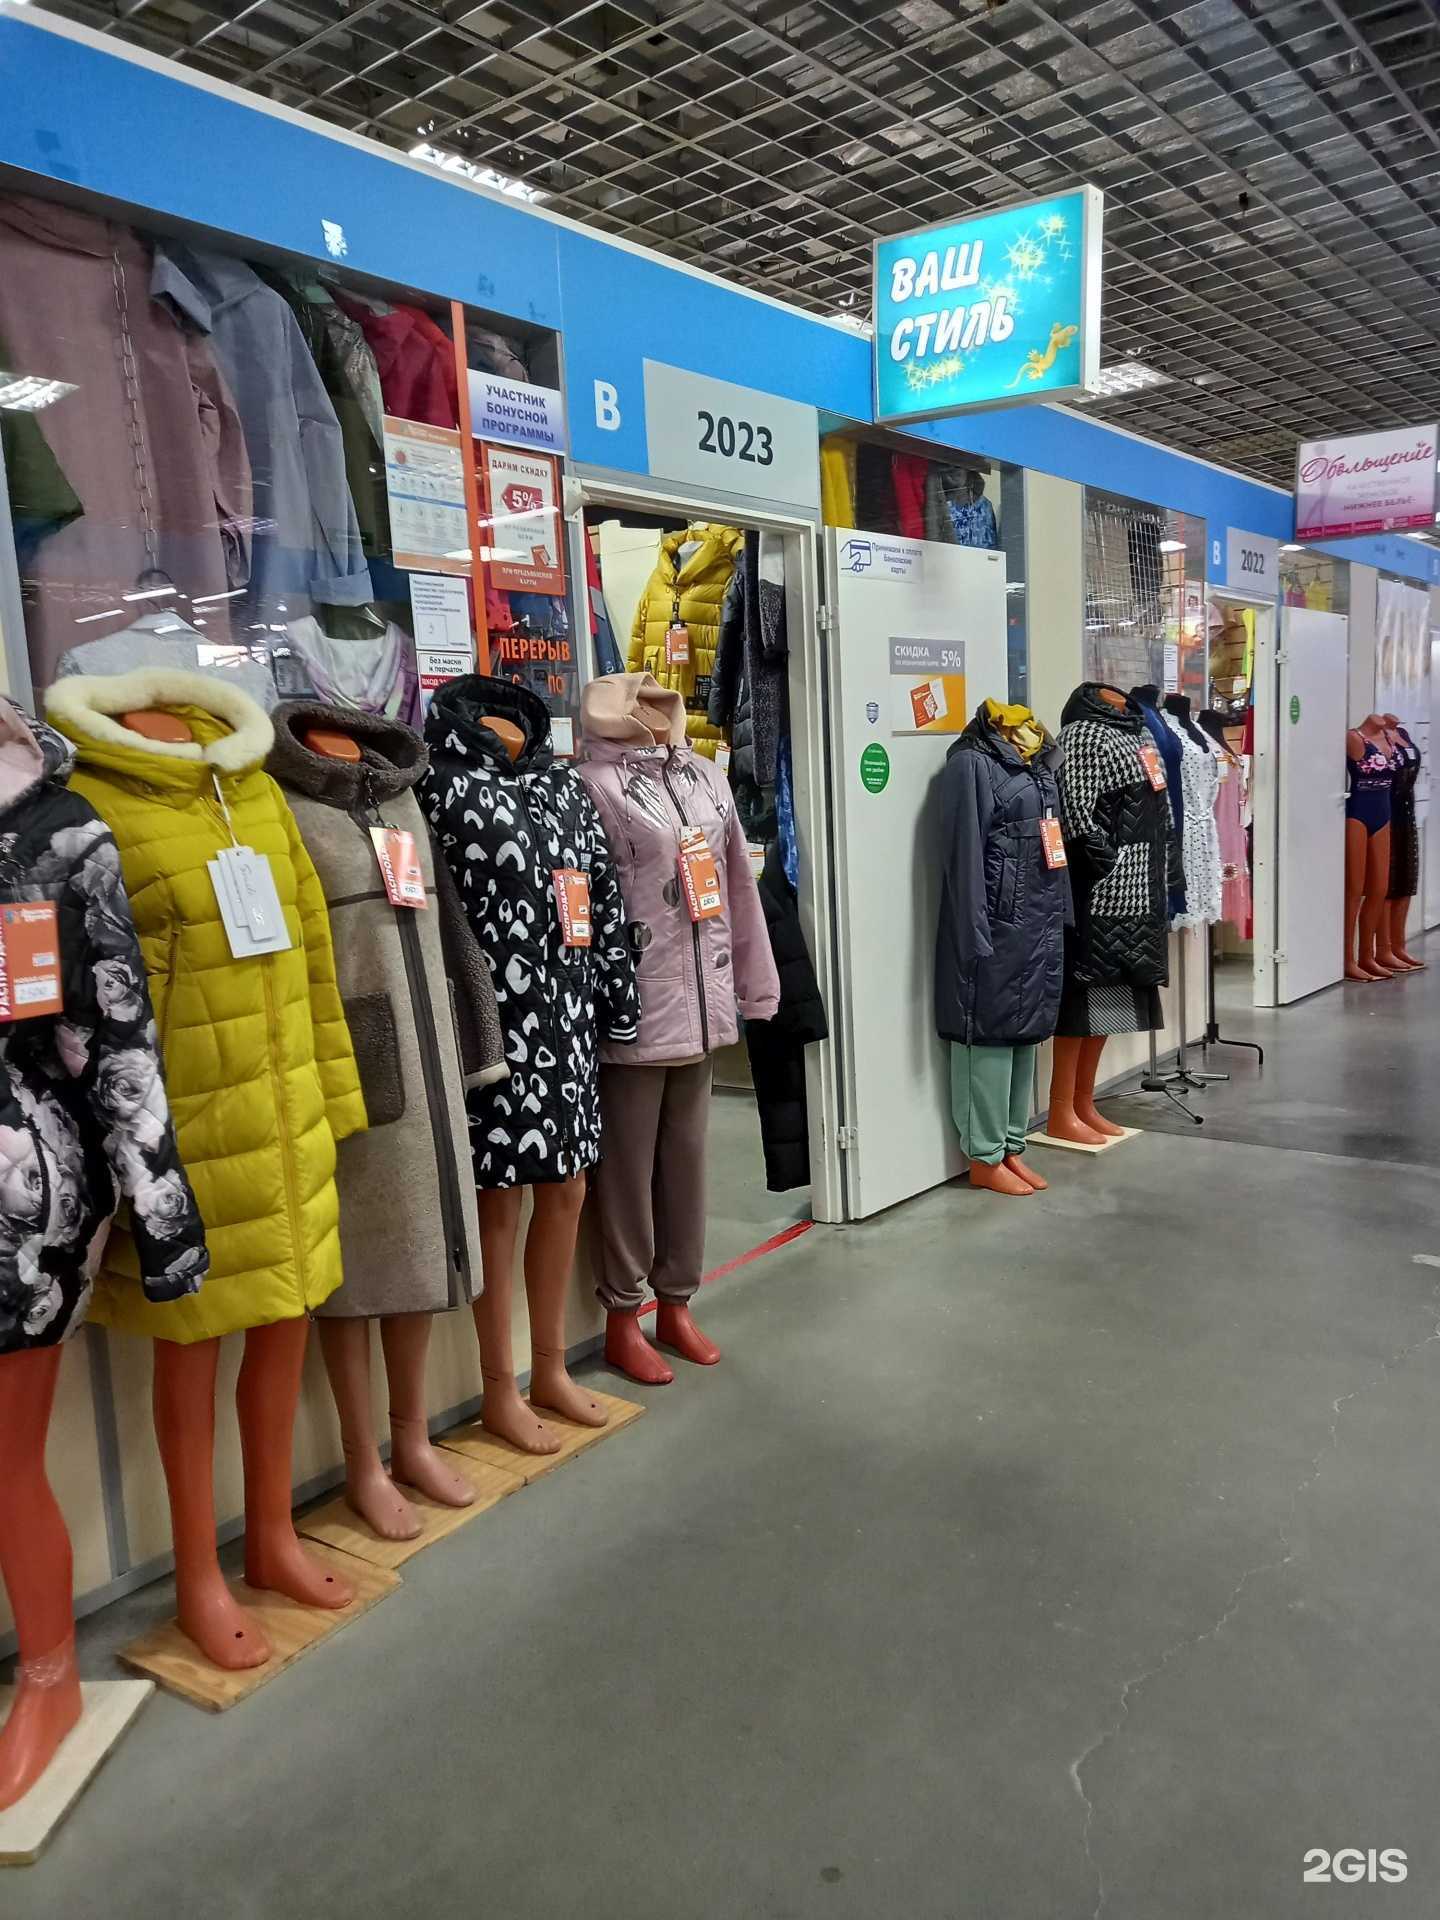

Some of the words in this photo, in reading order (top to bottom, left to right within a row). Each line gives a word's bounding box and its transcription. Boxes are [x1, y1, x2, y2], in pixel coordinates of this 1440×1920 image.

[890, 240, 984, 303] ВАШ
[890, 296, 1015, 361] СТИЛЬ
[486, 384, 546, 408] УЧАСТНИК
[486, 401, 548, 425] БОНУСНОЙ
[482, 418, 554, 442] ПРОГРАММЫ
[697, 411, 774, 466] 2023
[491, 460, 519, 473] ДАРИМ
[520, 465, 548, 478] СКИДКУ
[512, 489, 537, 510] 5%
[1240, 549, 1265, 575] 2022
[429, 656, 441, 665] Без
[442, 658, 461, 666] маски
[499, 637, 571, 661] ПЕРЕРЫВ
[894, 645, 930, 659] СКИДКА
[940, 649, 961, 668] 5%
[434, 666, 463, 675] перчаток
[548, 674, 565, 696] ПО
[679, 855, 701, 918] РАСПРОДАЖА
[557, 874, 573, 943] РАСПРОДАЖА
